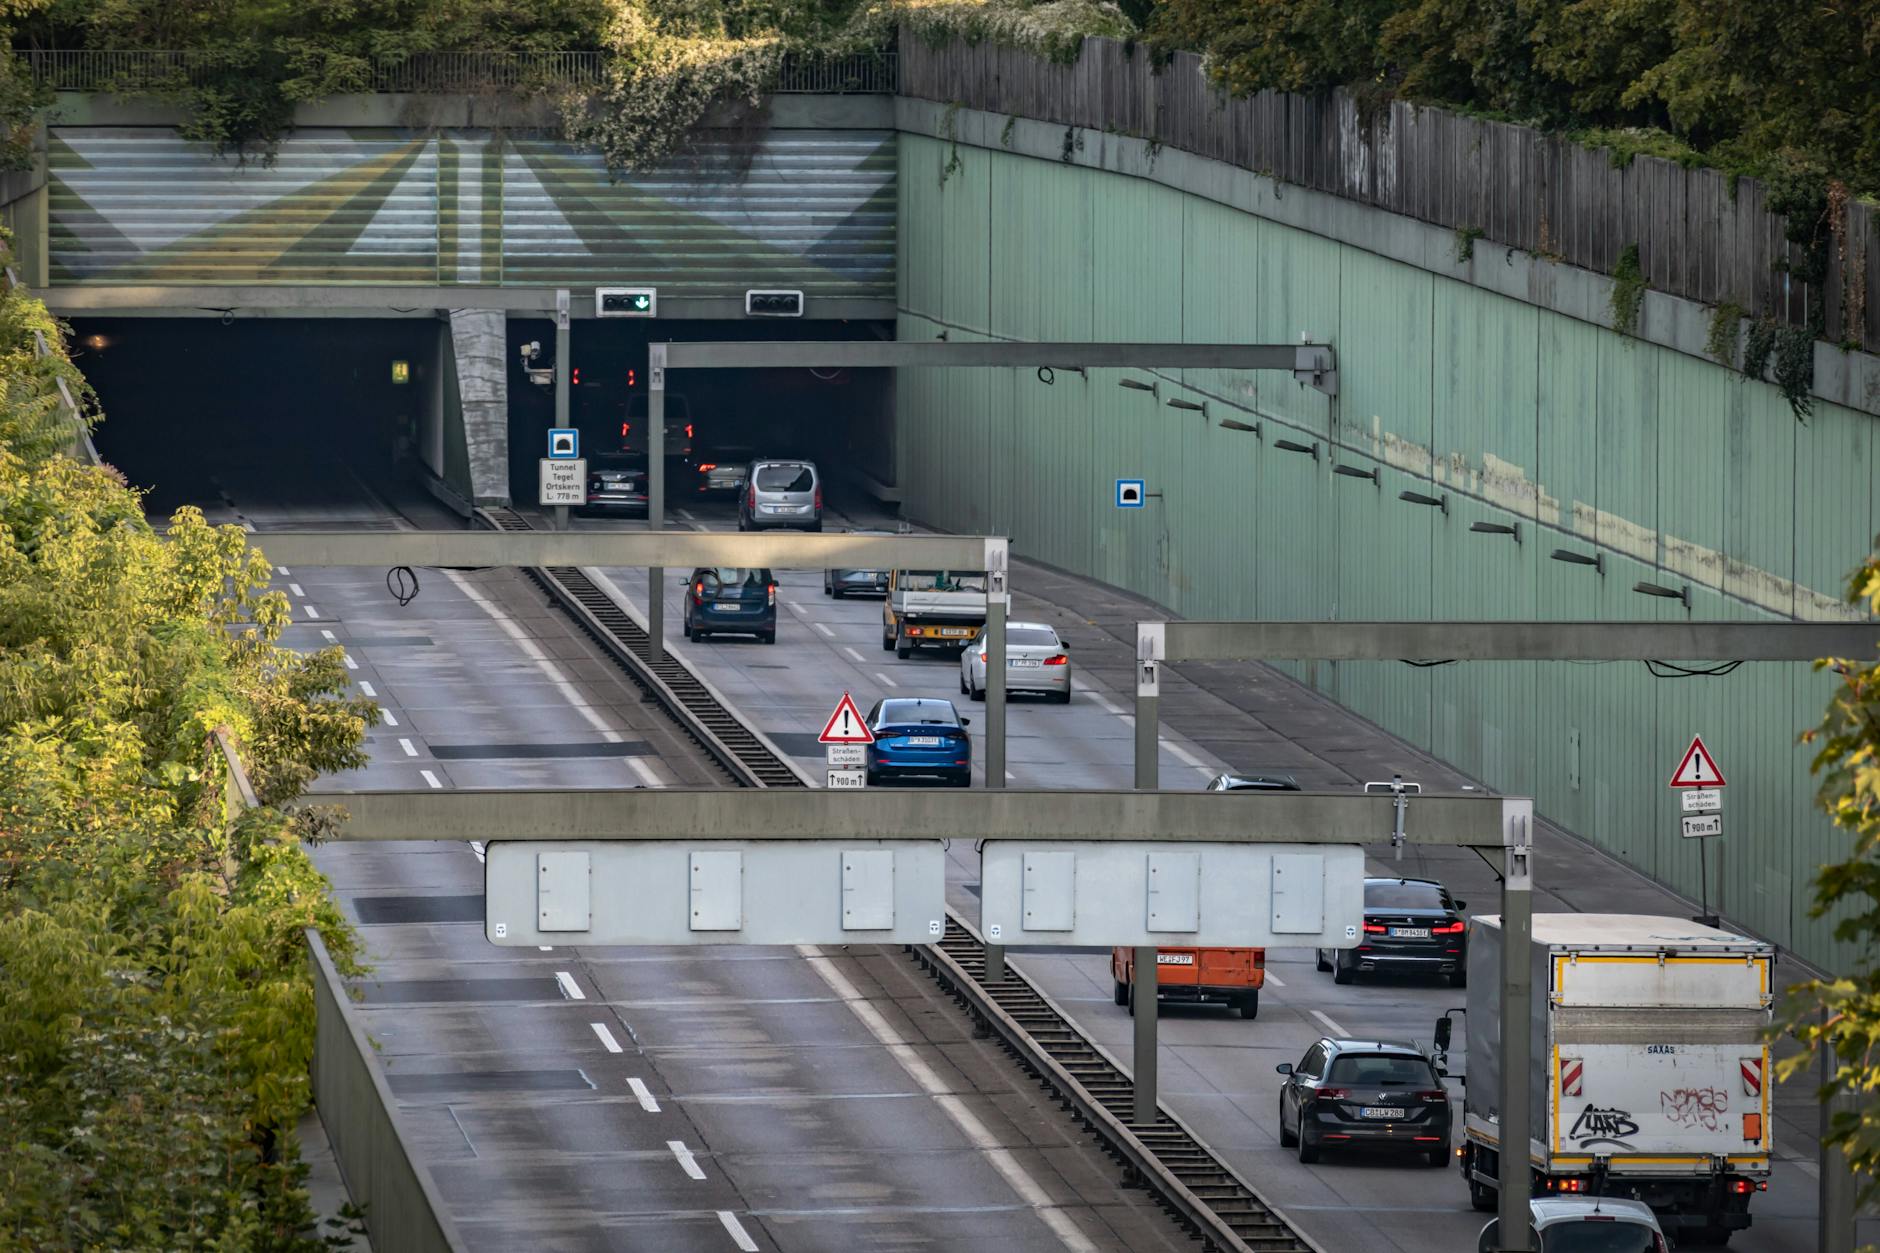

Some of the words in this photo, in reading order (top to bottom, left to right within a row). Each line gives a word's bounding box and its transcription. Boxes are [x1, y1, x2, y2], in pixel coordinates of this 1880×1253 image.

[552, 473, 574, 482] Tegel
[546, 482, 580, 490] Ortskern
[837, 777, 849, 785] 900
[1692, 823, 1705, 832] 900
[1647, 1045, 1675, 1054] SAXAS
